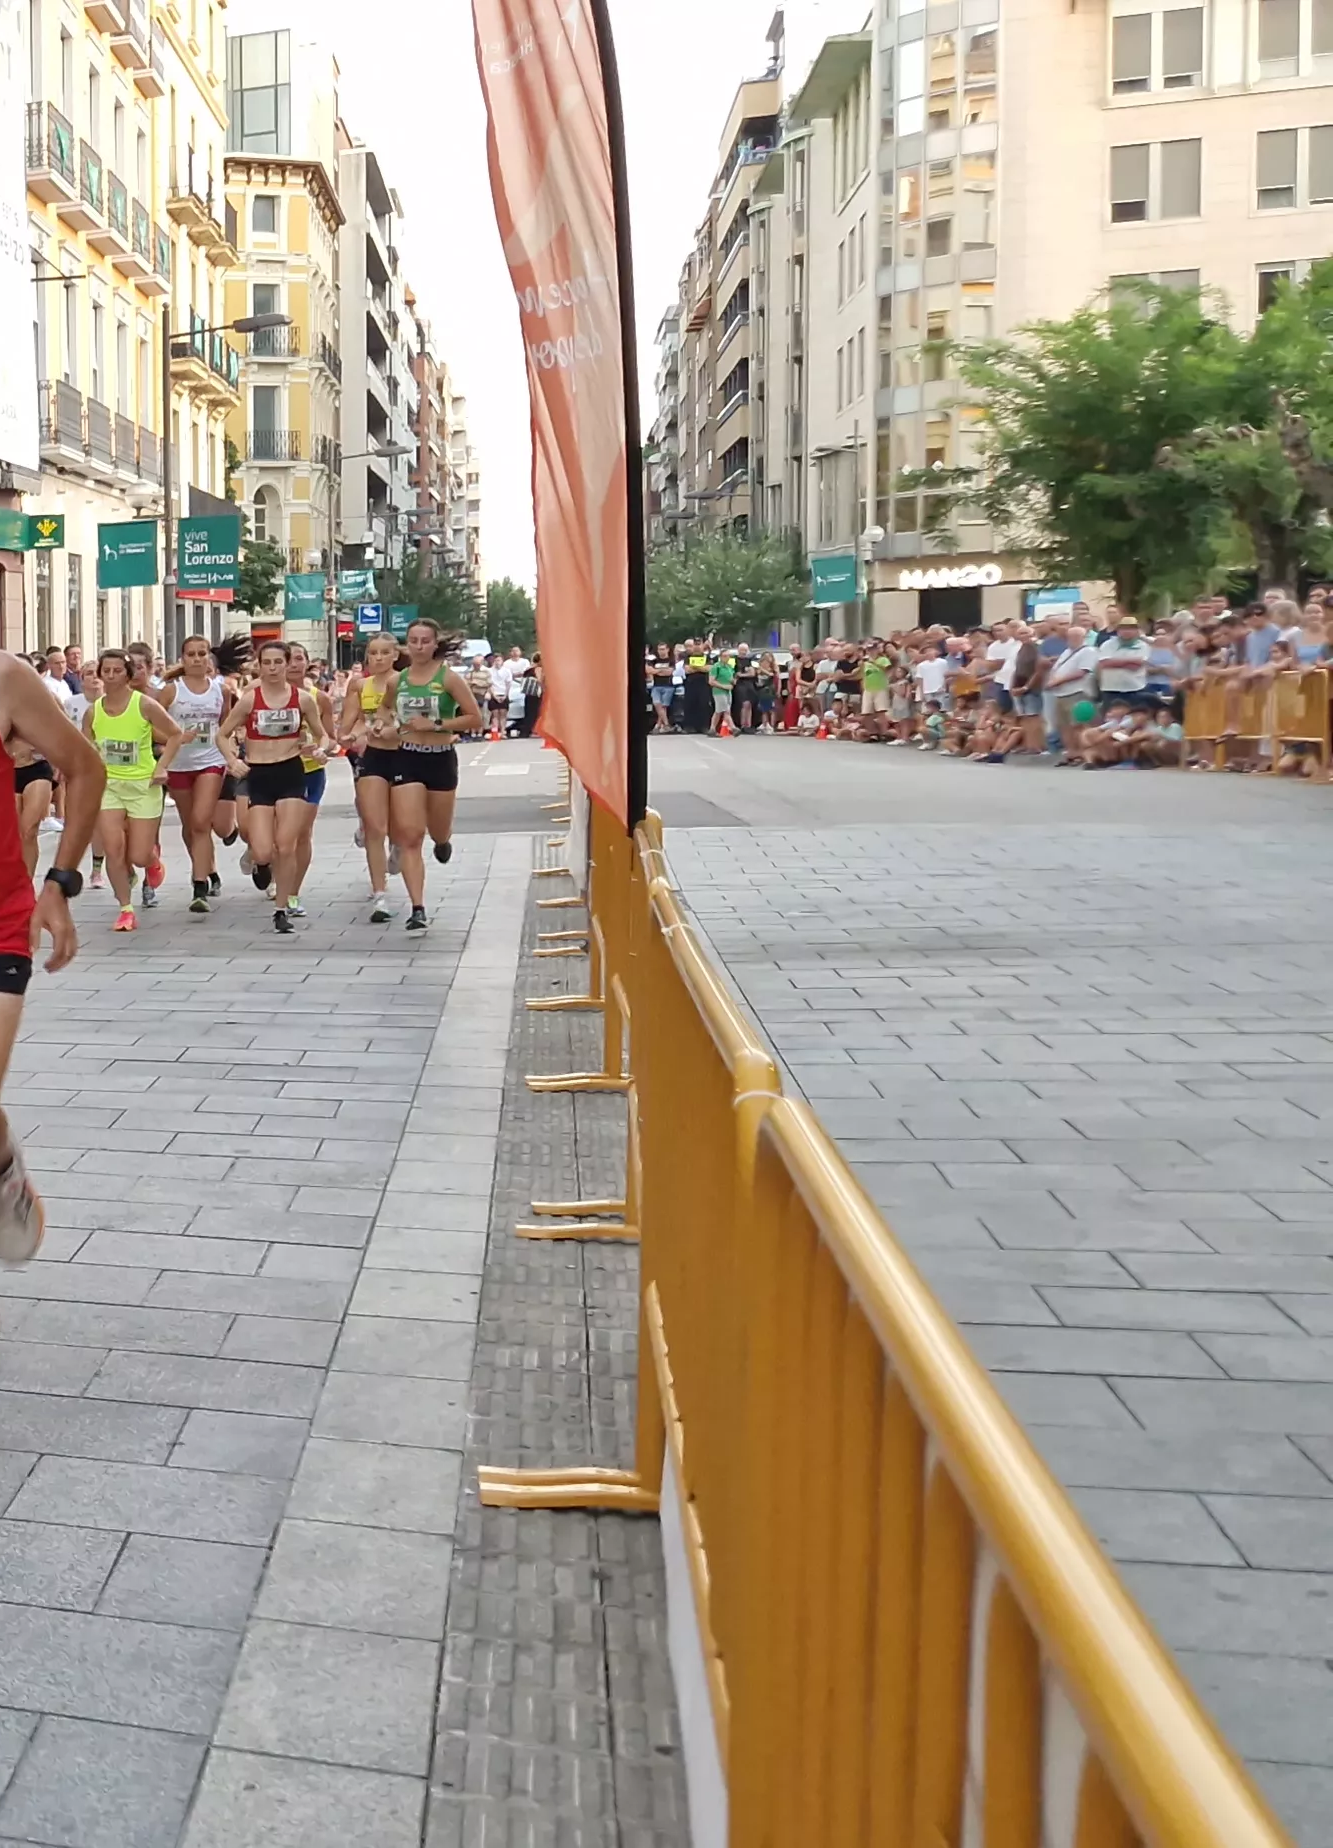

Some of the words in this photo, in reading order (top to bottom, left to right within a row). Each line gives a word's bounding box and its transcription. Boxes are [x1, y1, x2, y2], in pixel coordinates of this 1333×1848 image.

[184, 528, 208, 541] vive
[184, 541, 208, 553] San
[184, 553, 234, 566] Lorenzo
[899, 563, 1002, 590] MANGO
[408, 697, 425, 707] 23
[271, 709, 287, 720] 28
[402, 741, 452, 753] UNDER
